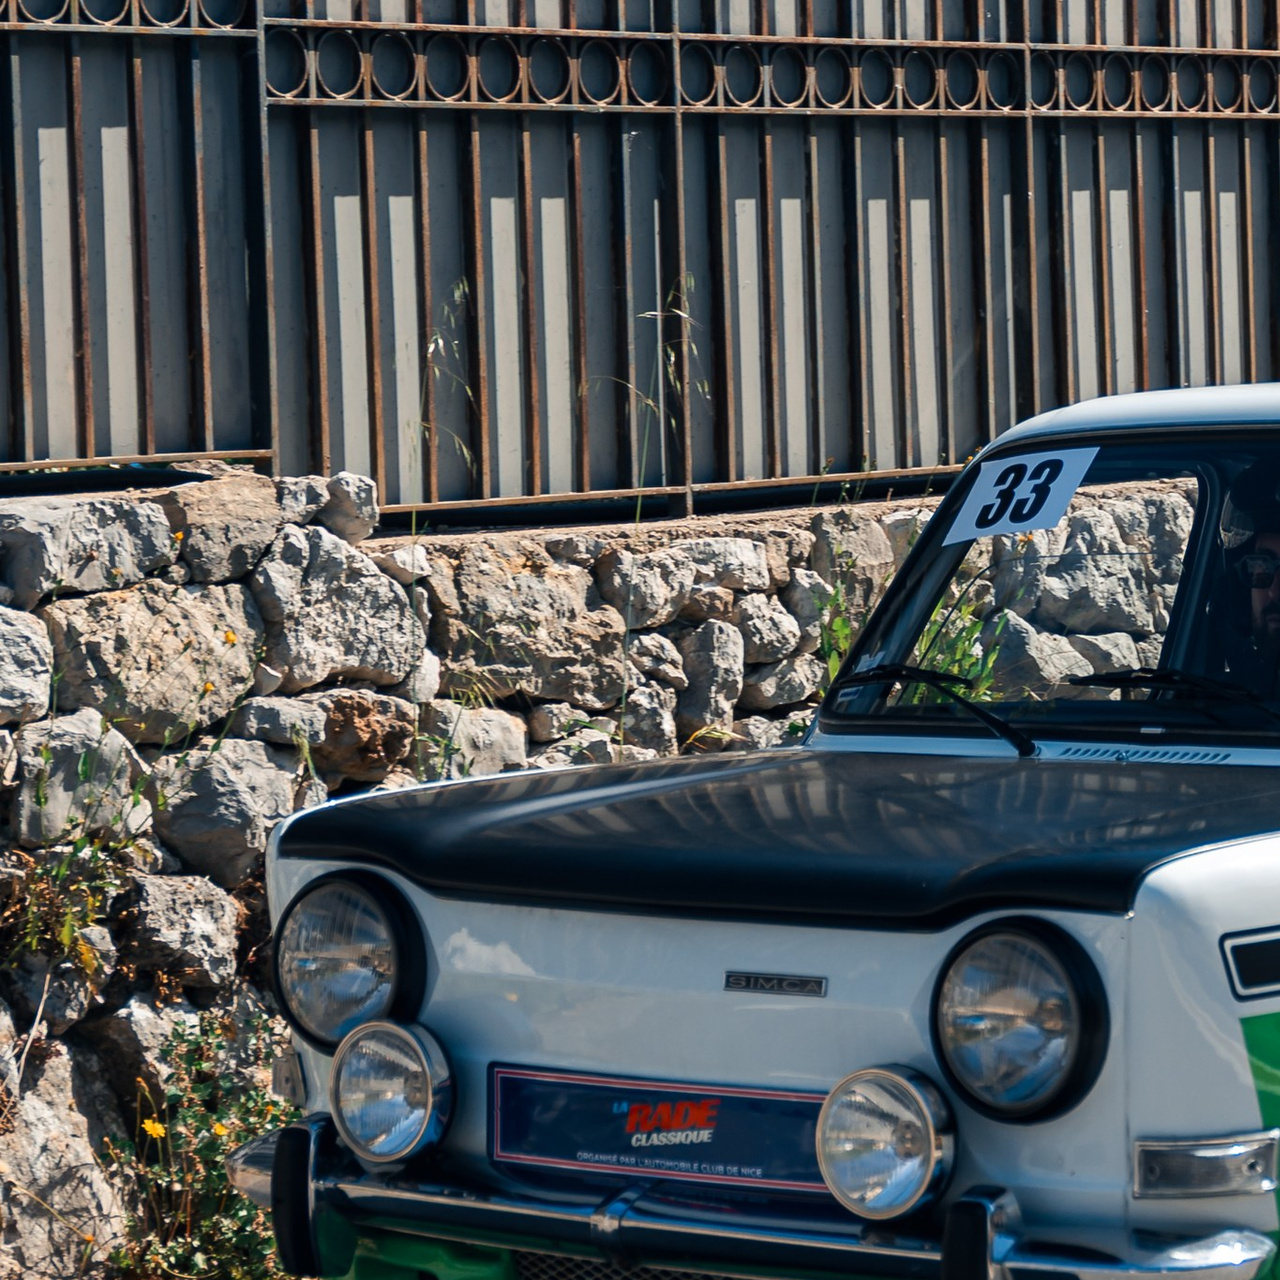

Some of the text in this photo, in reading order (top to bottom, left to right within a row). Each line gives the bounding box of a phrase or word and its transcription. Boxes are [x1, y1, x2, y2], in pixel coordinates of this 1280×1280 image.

[975, 458, 1064, 529] 33
[728, 976, 819, 993] SIMCA
[612, 1098, 721, 1134] LA RADE
[631, 1130, 714, 1148] CLASSIQUE
[620, 1155, 636, 1166] PAR
[701, 1164, 724, 1174] CLUB
[726, 1166, 739, 1176] DE
[741, 1167, 763, 1178] NICE
